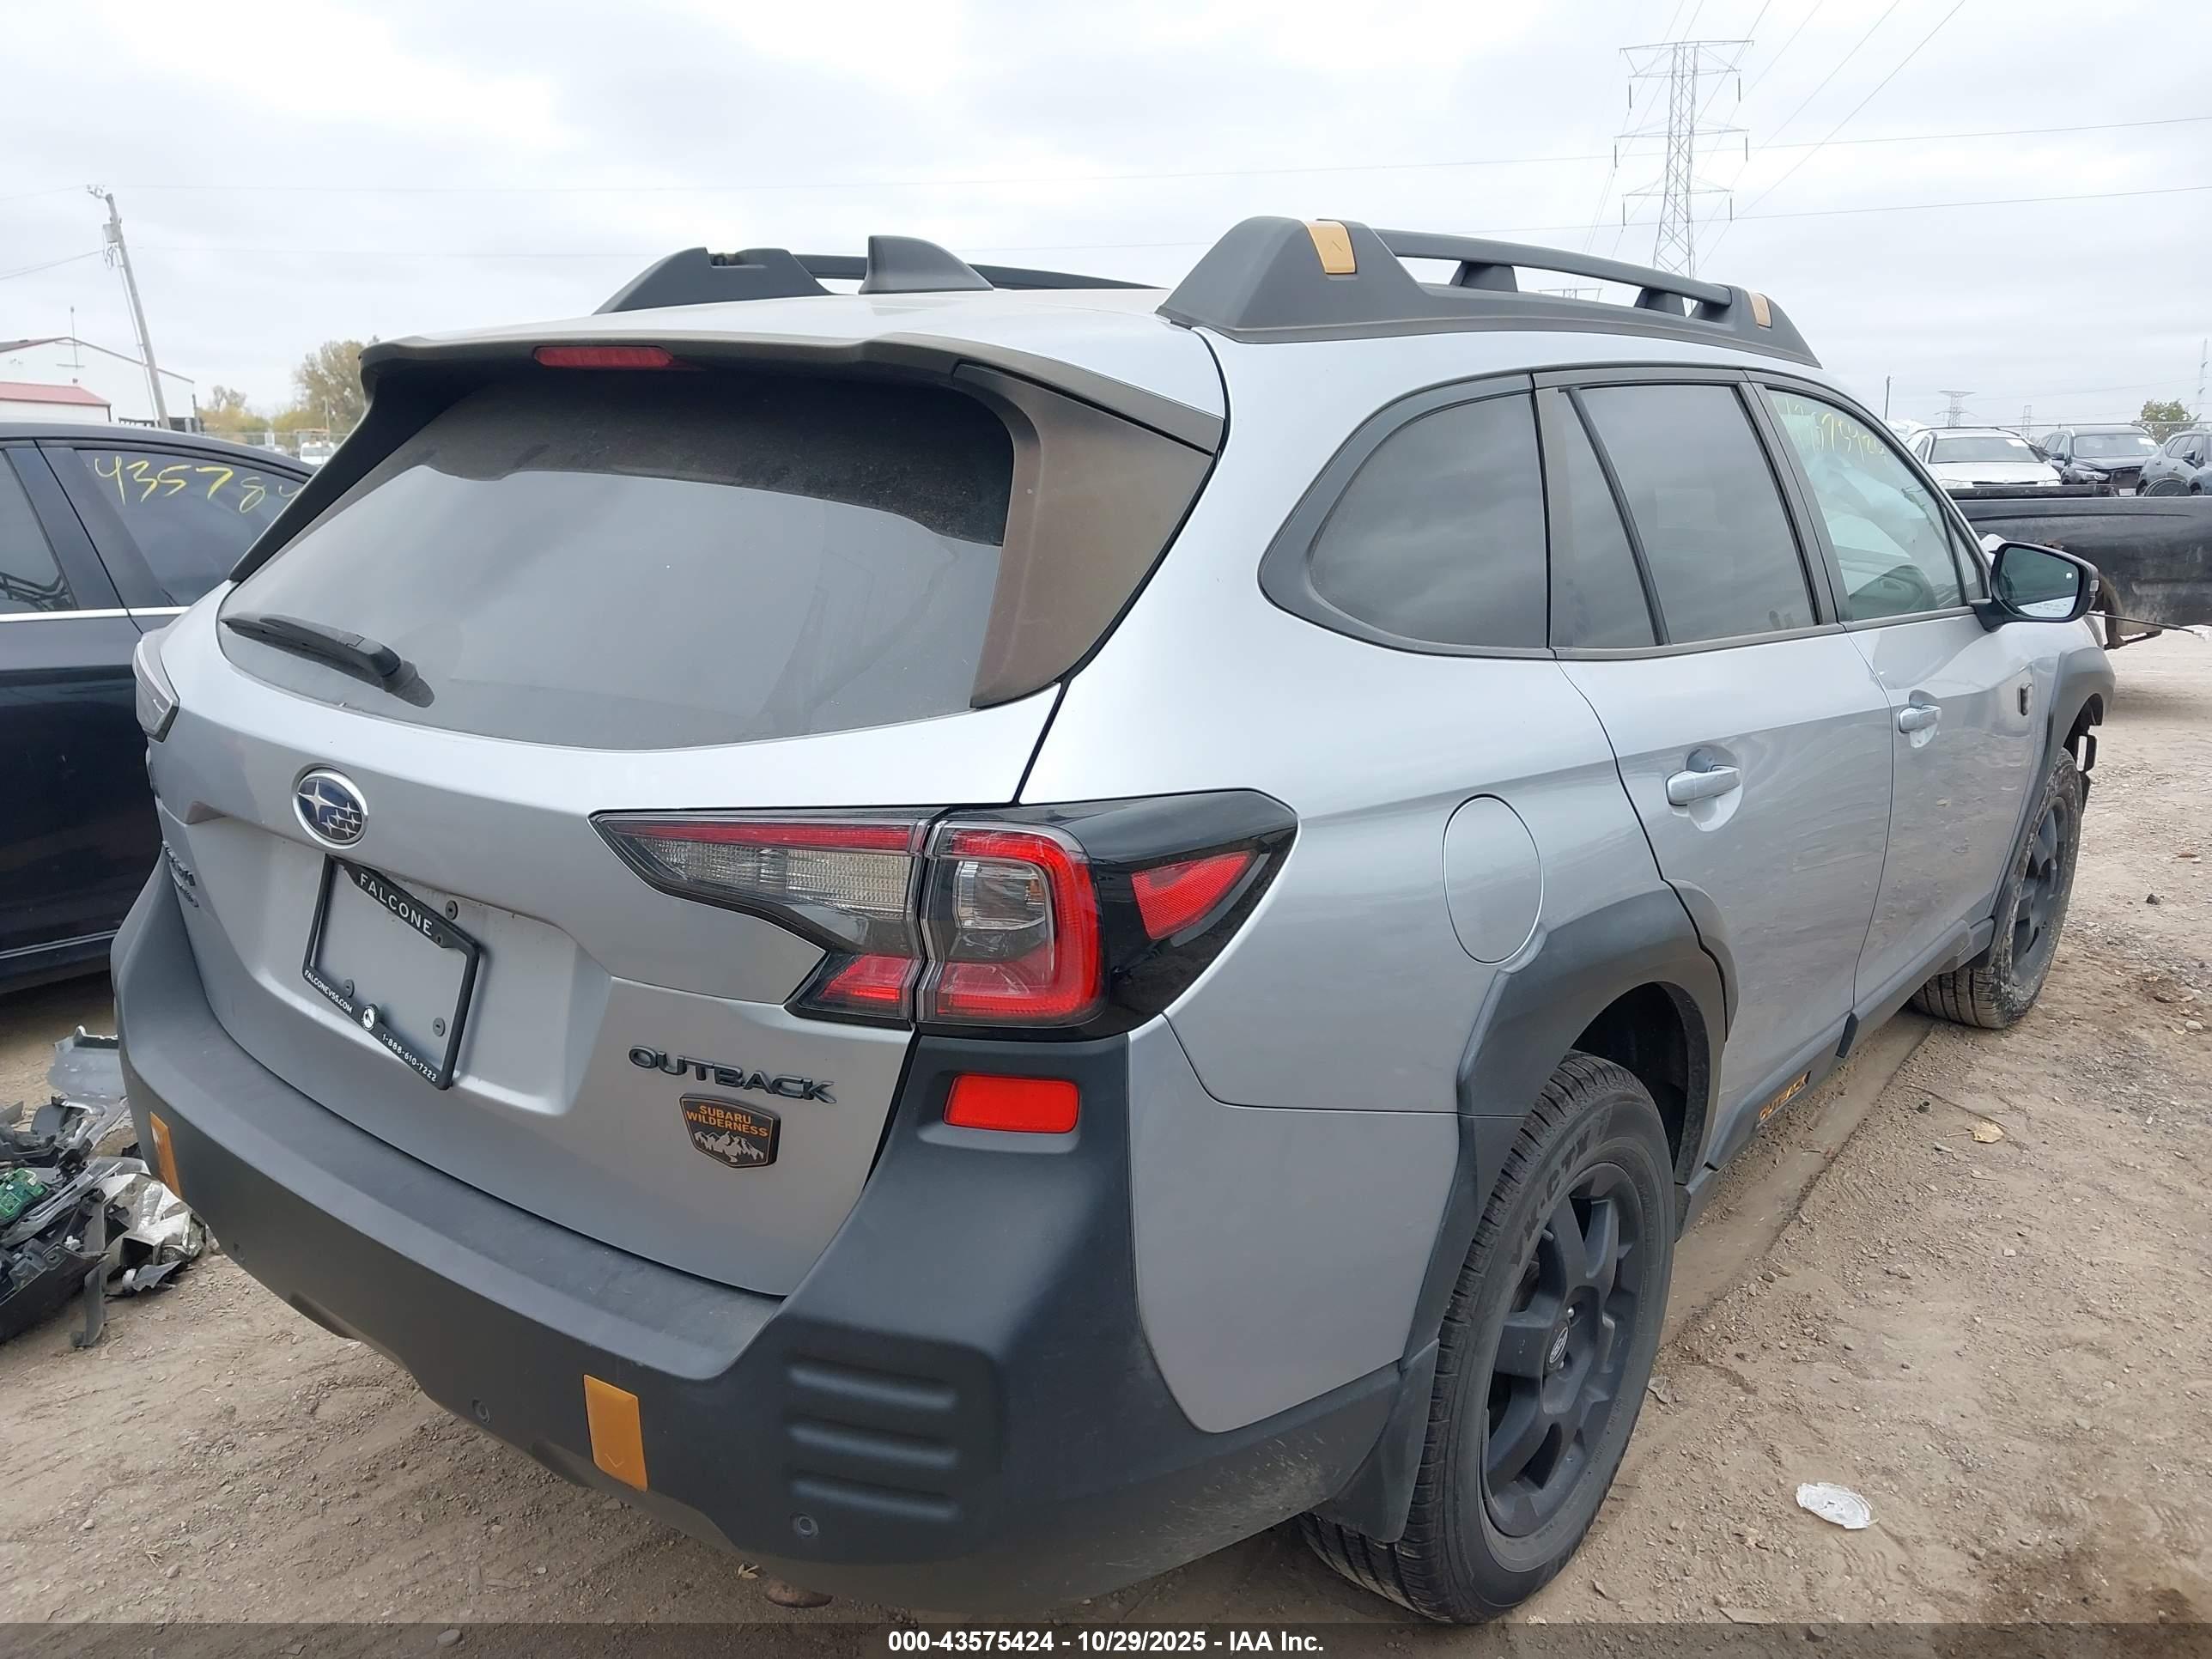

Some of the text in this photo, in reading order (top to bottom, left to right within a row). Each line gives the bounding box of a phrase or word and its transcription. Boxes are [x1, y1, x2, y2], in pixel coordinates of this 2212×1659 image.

[360, 872, 433, 937] FALCONE
[304, 969, 353, 1014] FALCONEVSS.COM
[381, 1033, 437, 1083] 1-888-610-7222
[628, 1045, 837, 1104] OUTBACK
[686, 1110, 769, 1138] WILDERNESS
[699, 1105, 751, 1126] SUBARU
